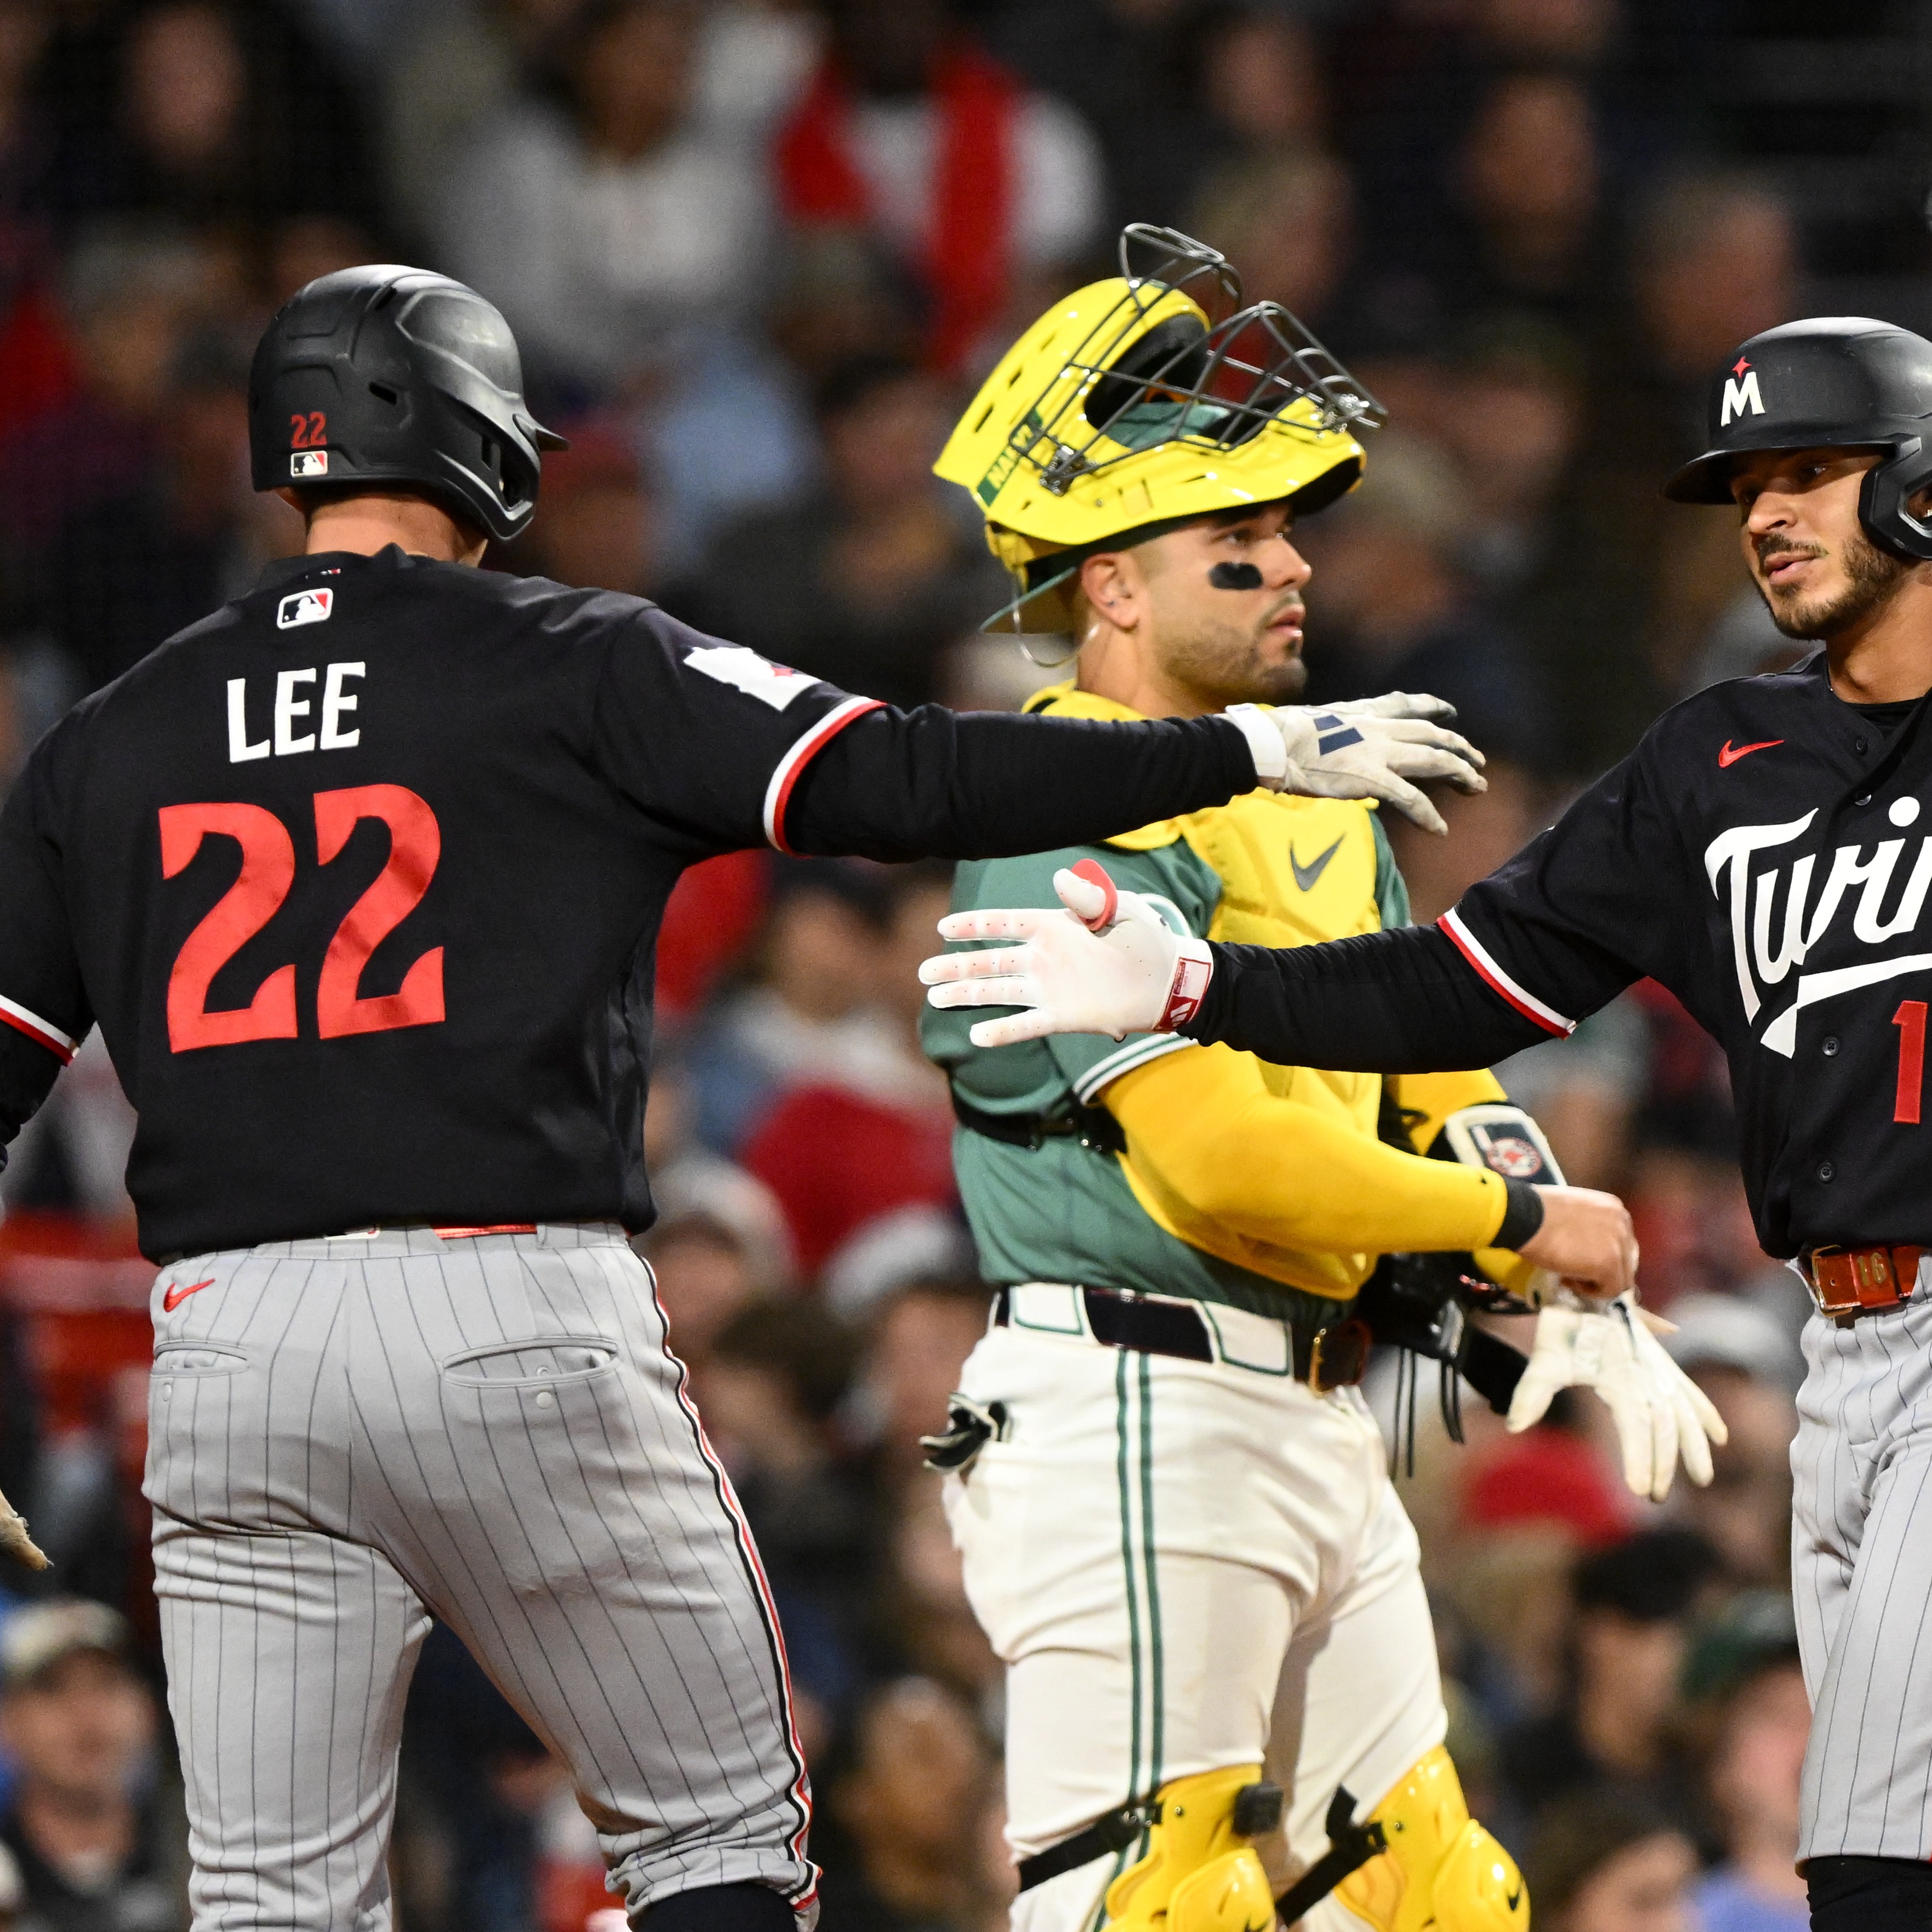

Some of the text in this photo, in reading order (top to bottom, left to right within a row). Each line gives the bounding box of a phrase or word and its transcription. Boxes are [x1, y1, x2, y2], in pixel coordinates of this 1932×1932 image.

[290, 411, 327, 448] 22
[1720, 371, 1766, 428] M
[227, 661, 366, 763] LEE
[158, 783, 446, 1053] 22
[1705, 796, 1932, 1027] Twi
[1857, 1251, 1887, 1287] 16
